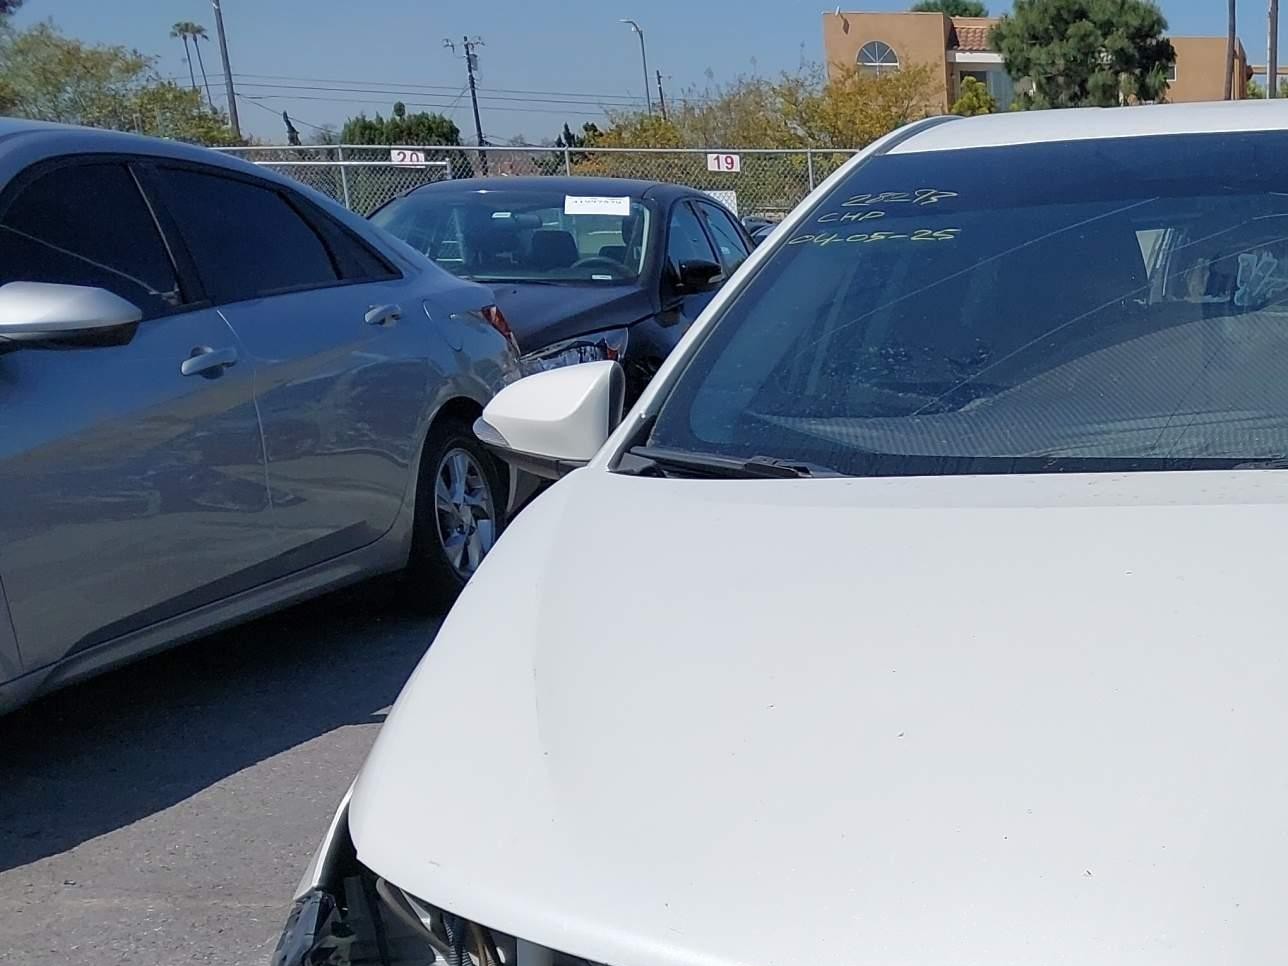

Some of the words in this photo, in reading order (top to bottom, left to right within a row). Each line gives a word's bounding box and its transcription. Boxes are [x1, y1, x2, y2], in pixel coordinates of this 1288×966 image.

[397, 151, 419, 163] 20
[713, 154, 734, 170] 19
[817, 211, 886, 223] CHP
[788, 229, 962, 246] 04-05-25
